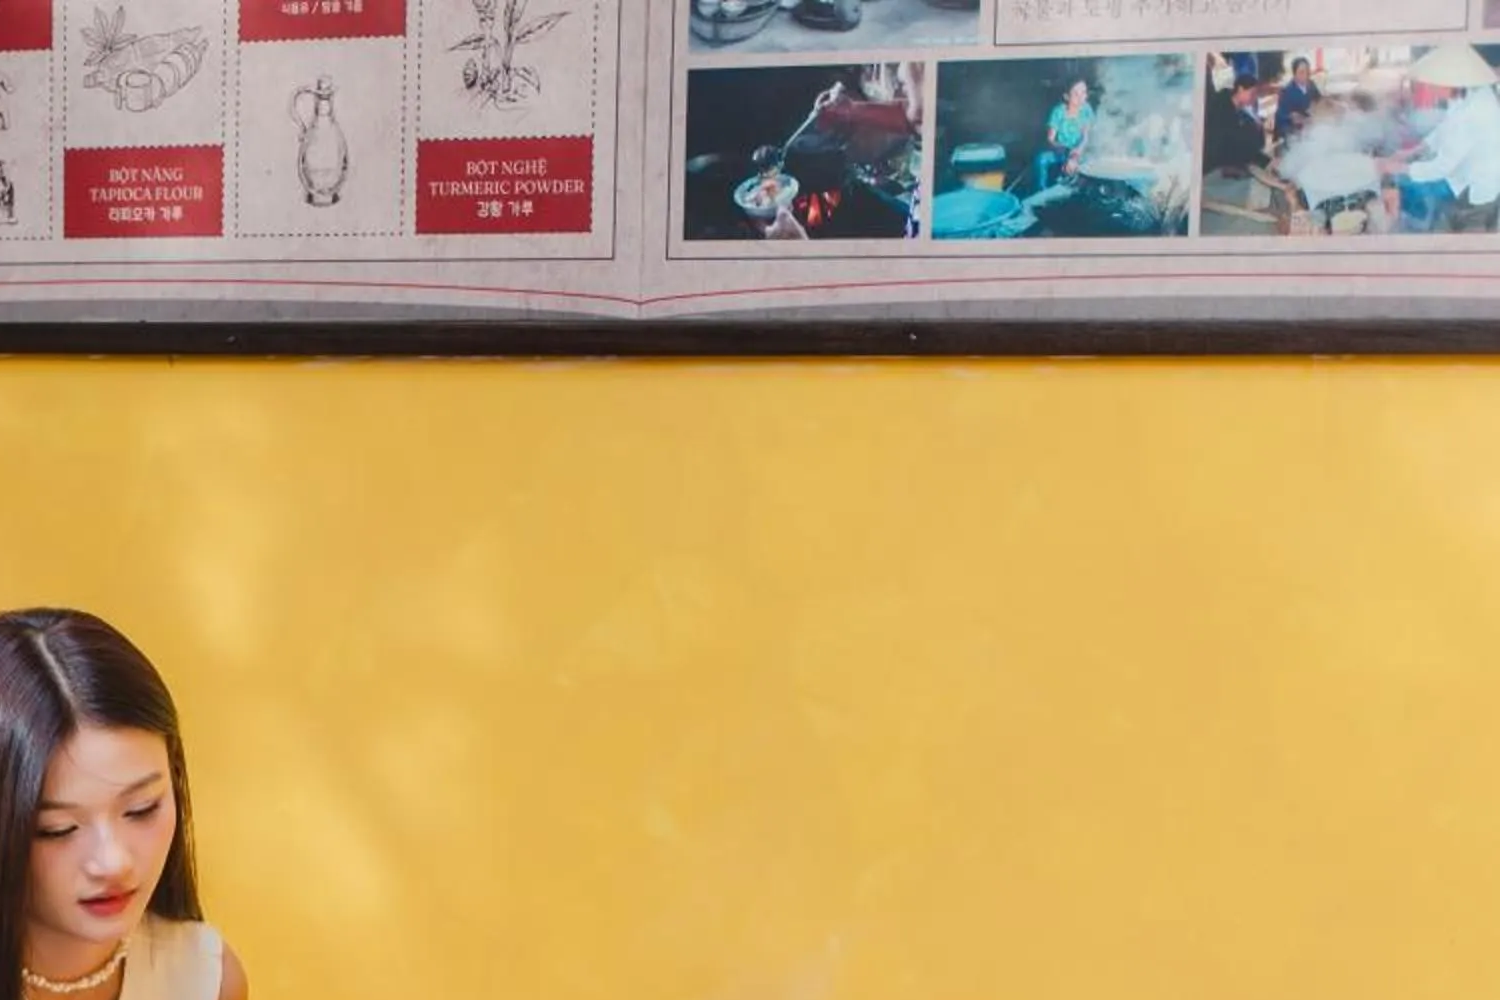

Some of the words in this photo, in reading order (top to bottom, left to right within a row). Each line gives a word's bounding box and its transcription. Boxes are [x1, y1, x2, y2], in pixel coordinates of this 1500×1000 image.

[108, 165, 139, 184] BỘT
[466, 158, 498, 177] BỘT
[501, 156, 549, 177] NGHỆ
[89, 186, 153, 203] TAPIOCA
[154, 185, 204, 201] FLOUR
[429, 180, 512, 197] TURMERIC
[514, 178, 586, 195] POWDER
[507, 199, 535, 217] 가루
